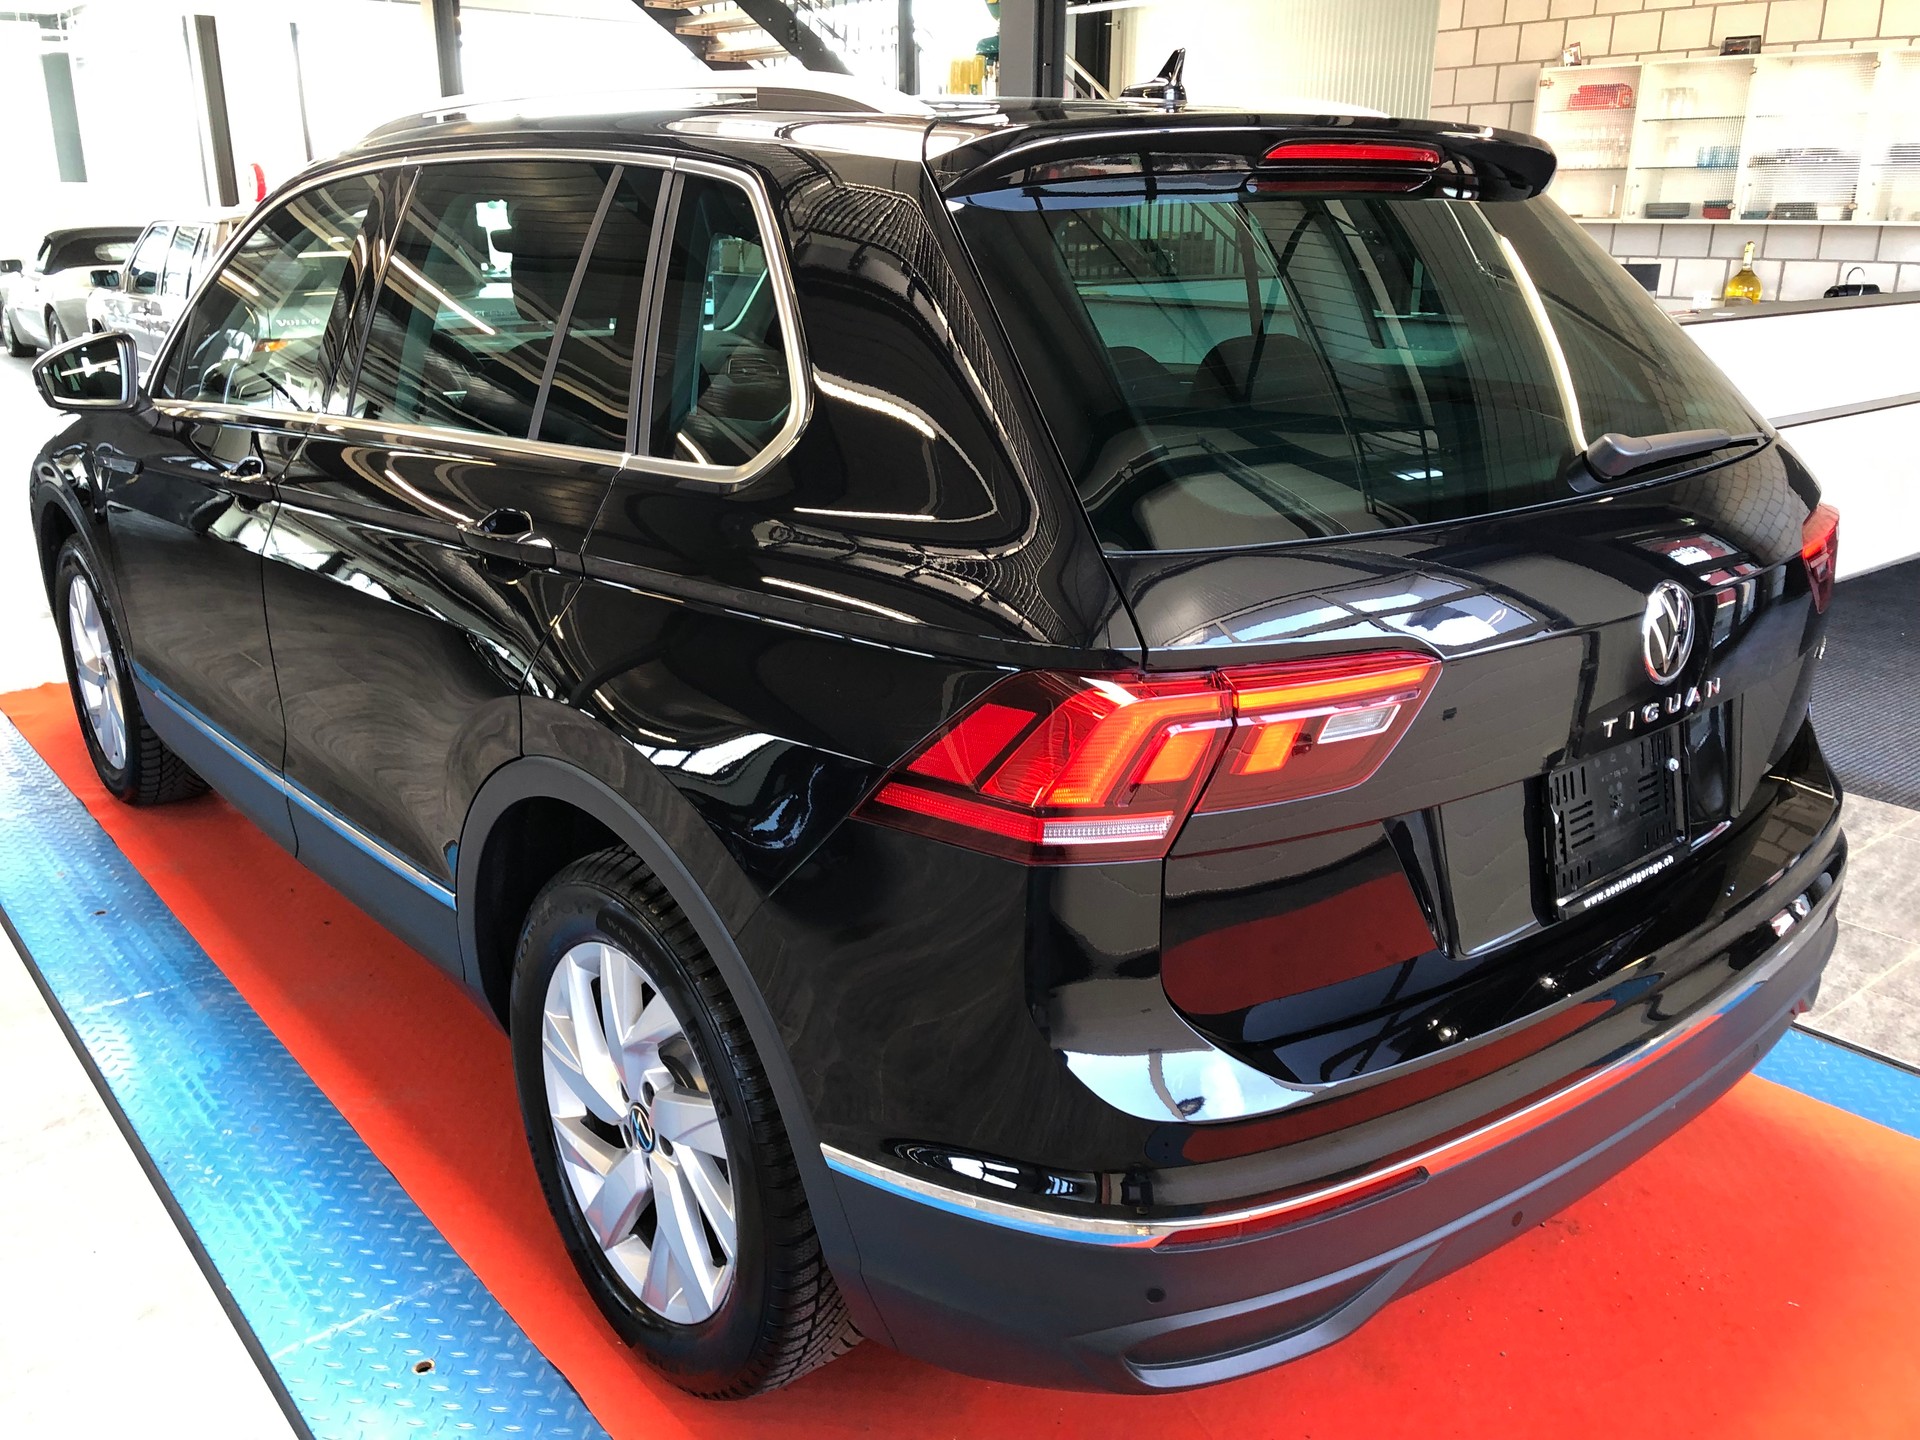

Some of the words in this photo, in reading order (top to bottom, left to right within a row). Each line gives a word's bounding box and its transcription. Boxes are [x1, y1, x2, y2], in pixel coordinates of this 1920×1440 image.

[275, 318, 321, 327] VOLVO
[1602, 677, 1720, 738] TIGUAN
[605, 916, 660, 976] WINTER
